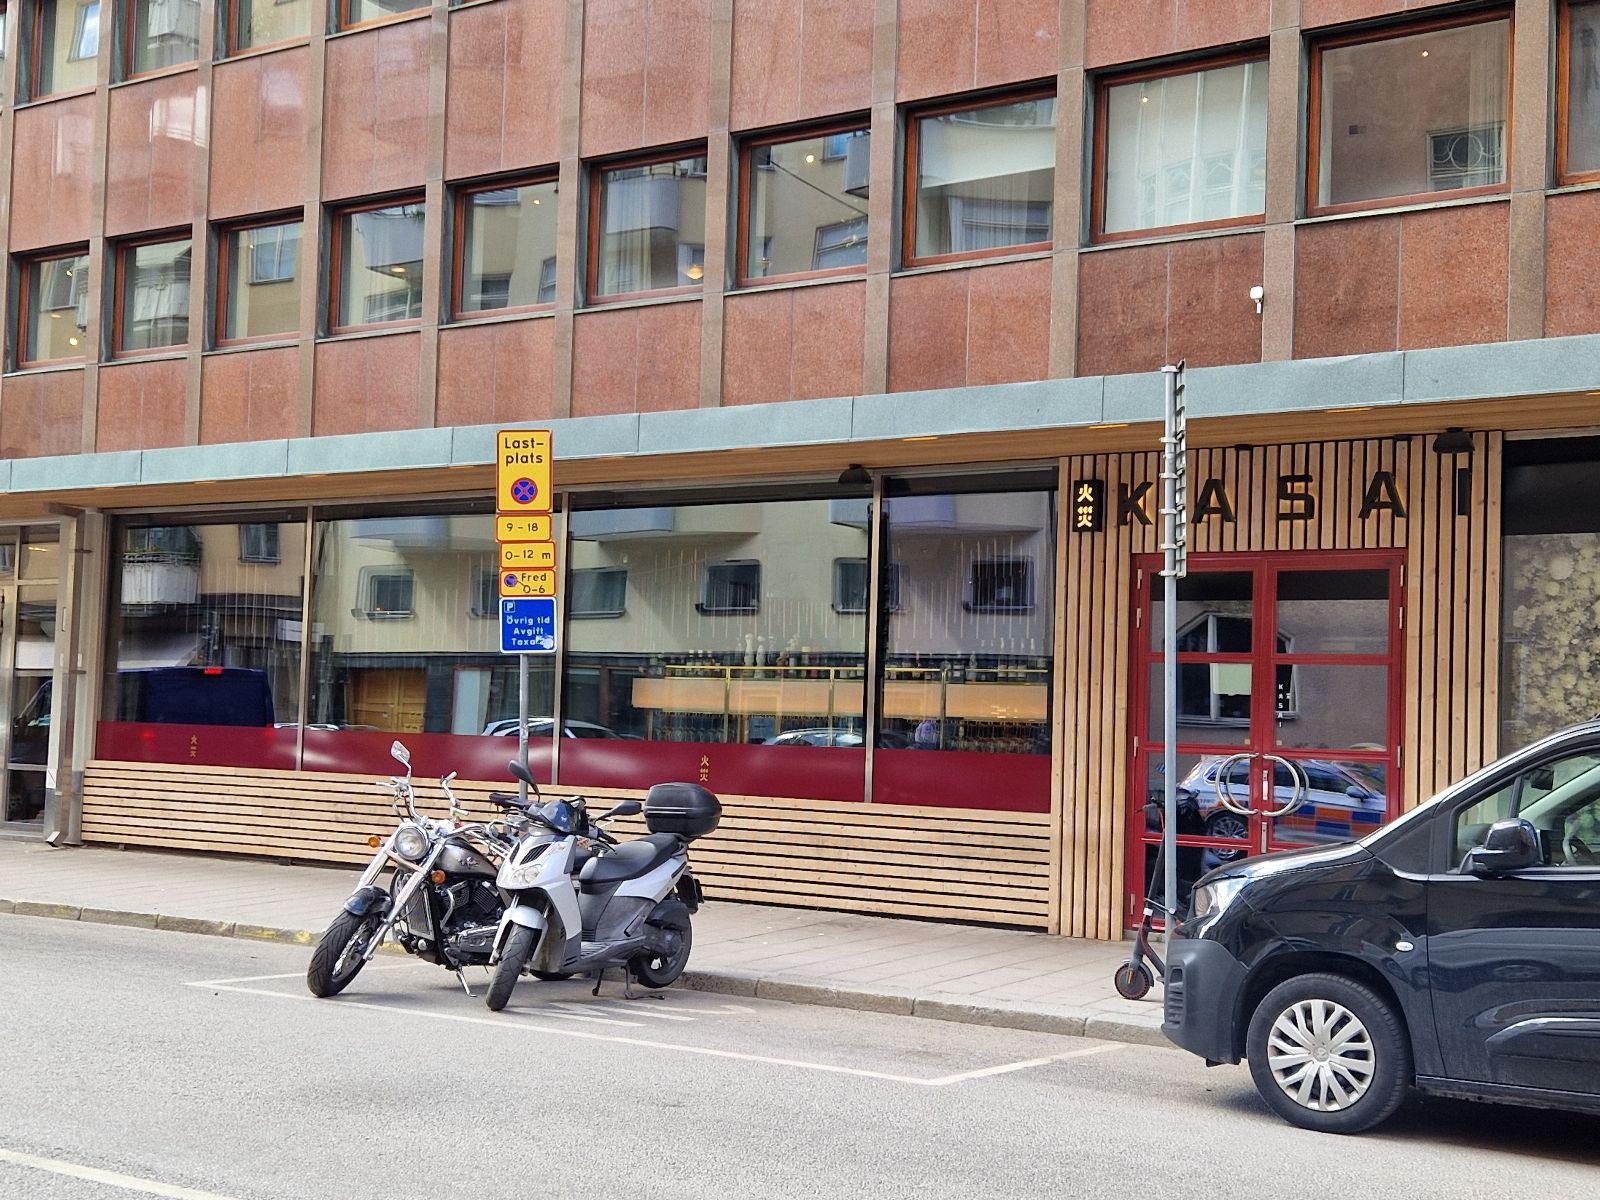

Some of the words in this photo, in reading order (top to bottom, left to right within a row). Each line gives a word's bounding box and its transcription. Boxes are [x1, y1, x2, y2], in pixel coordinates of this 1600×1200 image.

[504, 437, 545, 449] Last-
[505, 452, 543, 467] plats
[1117, 467, 1471, 527] KASAI
[1077, 483, 1094, 528] 火災
[541, 552, 551, 560] m
[521, 572, 547, 582] Fred
[506, 602, 514, 612] P
[506, 615, 534, 626] Övrig
[537, 616, 550, 624] tid
[513, 626, 544, 637] Avgift
[511, 637, 536, 646] Taxa
